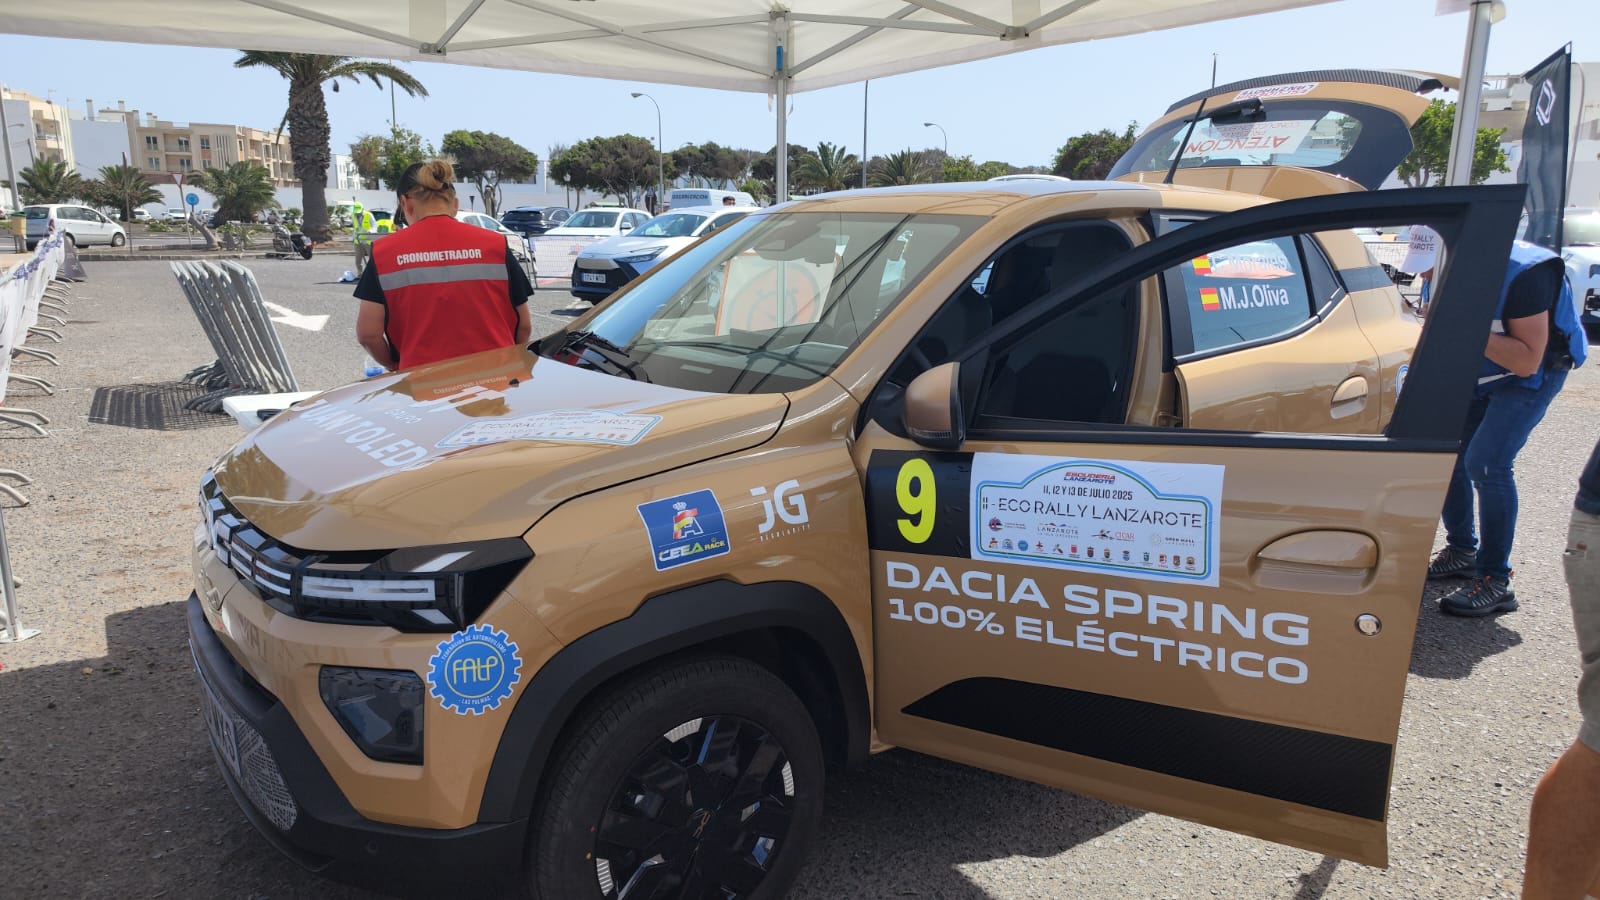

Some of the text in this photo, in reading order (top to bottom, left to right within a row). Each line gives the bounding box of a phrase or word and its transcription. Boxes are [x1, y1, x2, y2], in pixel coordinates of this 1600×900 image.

[1184, 134, 1291, 155] ATENCIÓN
[396, 248, 482, 266] CRONOMETRADOR
[1219, 284, 1290, 310] M.J.Oliva
[1064, 476, 1115, 485] LANZAROTE
[1065, 471, 1116, 481] ESCUDERIA
[896, 458, 937, 544] 9
[1052, 485, 1061, 495] 12
[1061, 486, 1067, 495] Y
[1068, 486, 1076, 496] 13
[1077, 487, 1088, 497] DE
[1089, 488, 1111, 499] JULIO
[1112, 490, 1134, 501] 2025
[998, 498, 1031, 513] ECO
[1034, 500, 1088, 517] RALLY
[1092, 505, 1202, 528] LANZAROTE
[886, 560, 1310, 646] DACIA SPRING
[889, 598, 1309, 684] 100% ELÉCTRICO
